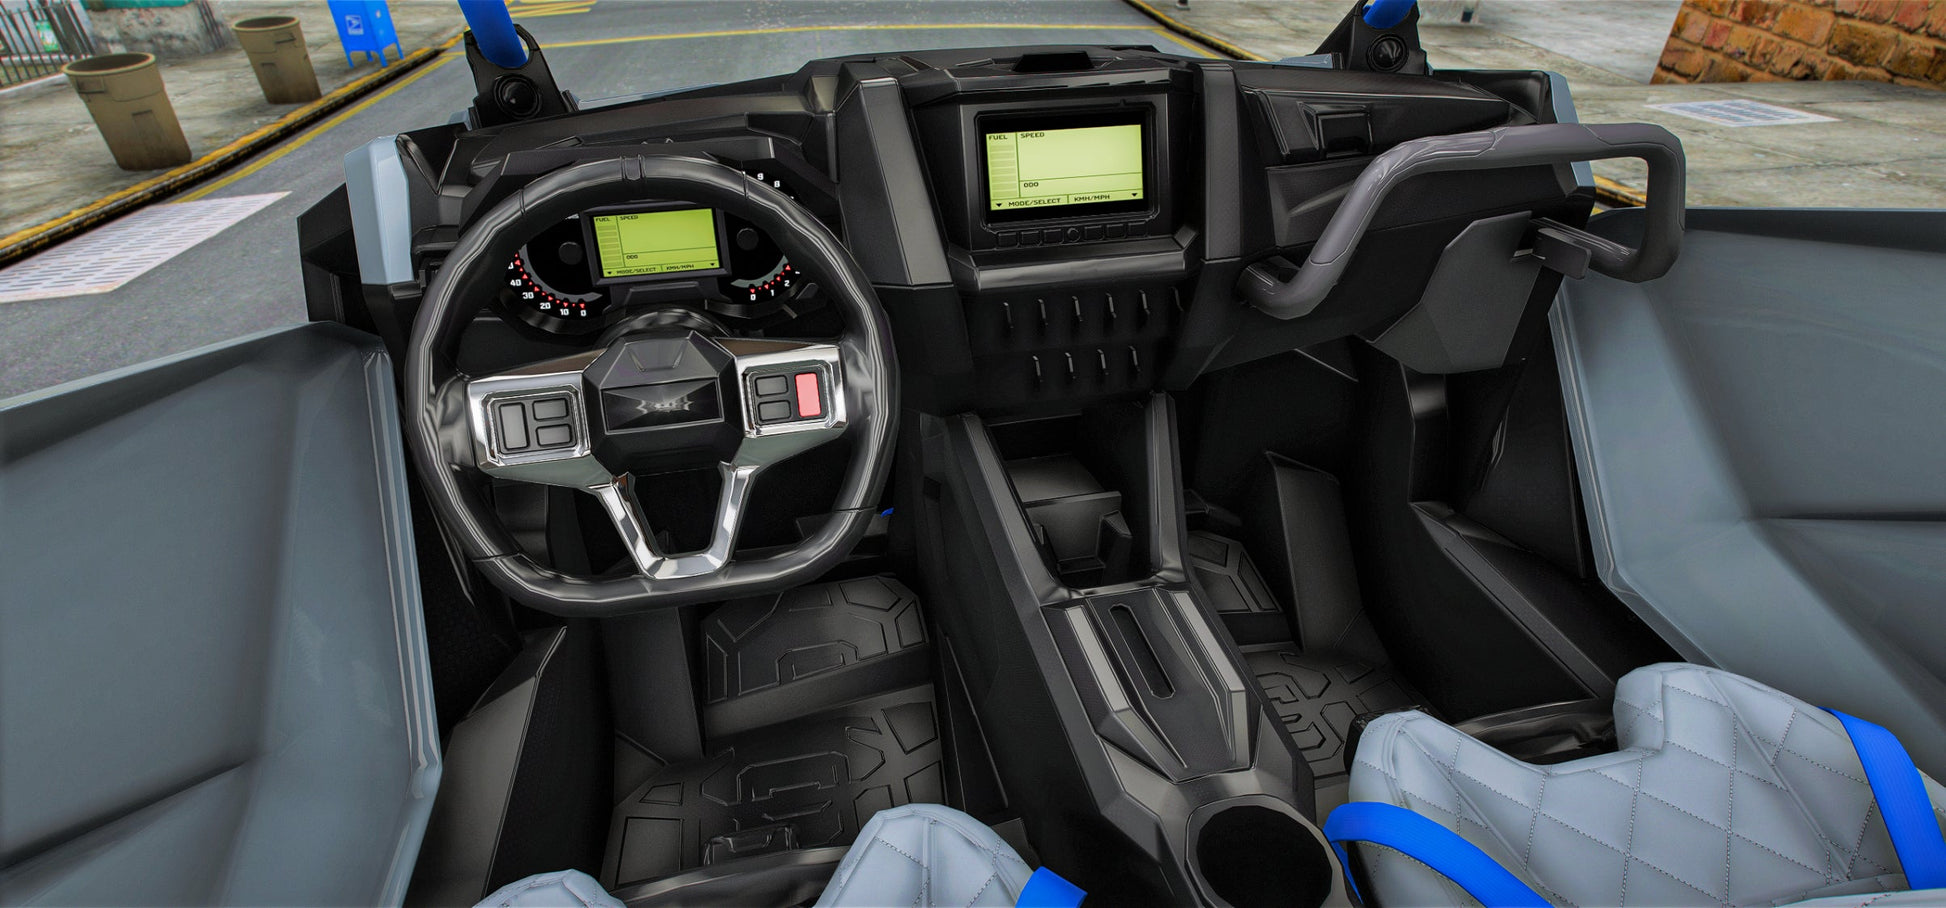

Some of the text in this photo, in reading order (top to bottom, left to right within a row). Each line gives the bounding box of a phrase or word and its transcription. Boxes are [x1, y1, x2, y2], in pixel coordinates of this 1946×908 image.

[1074, 194, 1111, 202] KMH/MPH
[1008, 198, 1061, 207] MODE/SELECT
[510, 279, 522, 287] 40
[540, 302, 551, 310] 20
[560, 308, 570, 316] 10
[580, 309, 587, 317] 0
